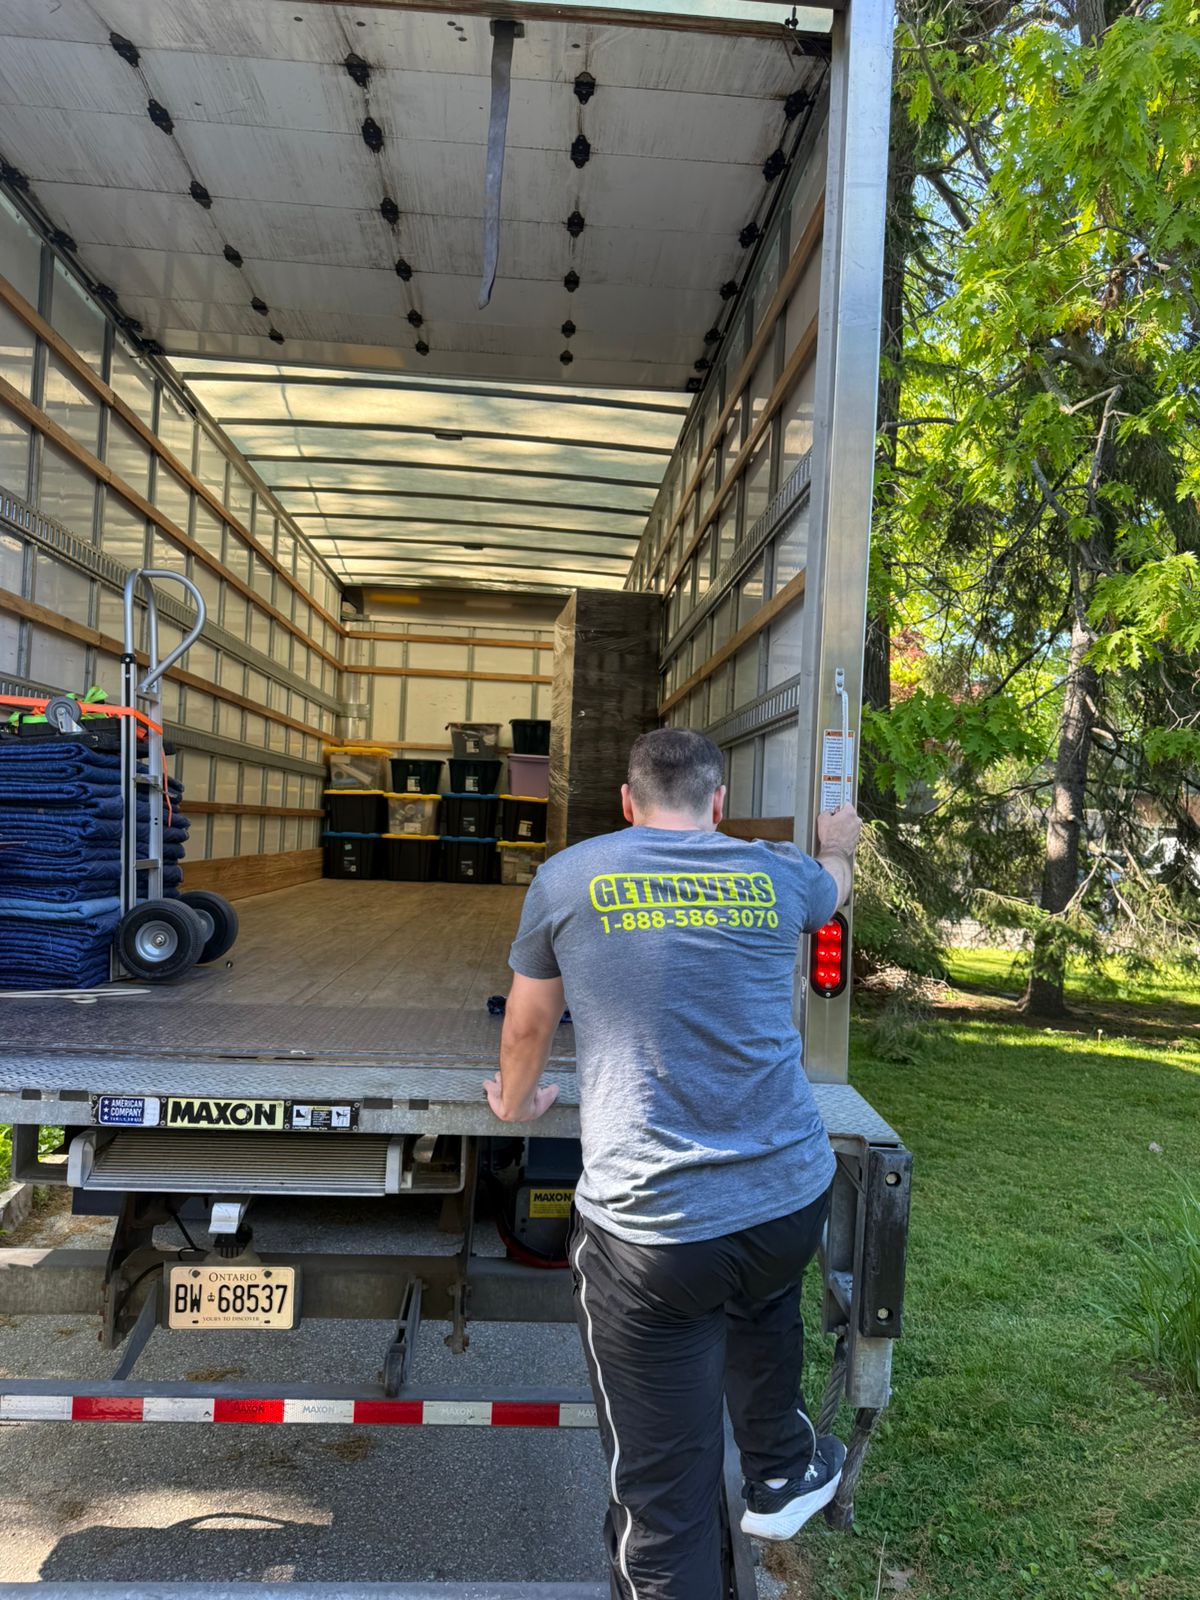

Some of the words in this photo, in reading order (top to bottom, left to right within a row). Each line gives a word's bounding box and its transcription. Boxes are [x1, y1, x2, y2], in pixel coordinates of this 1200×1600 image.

[592, 875, 775, 908] GETMOVERS
[600, 909, 779, 934] 1-888-586-3070
[111, 1099, 143, 1108] AMERICAN
[110, 1107, 142, 1117] COMPANY
[169, 1101, 277, 1126] MAXON
[534, 1193, 572, 1202] MAXON
[175, 1283, 203, 1314] BW
[218, 1284, 288, 1314] 68537
[302, 1405, 335, 1414] MAXON
[441, 1407, 473, 1416] MAXON
